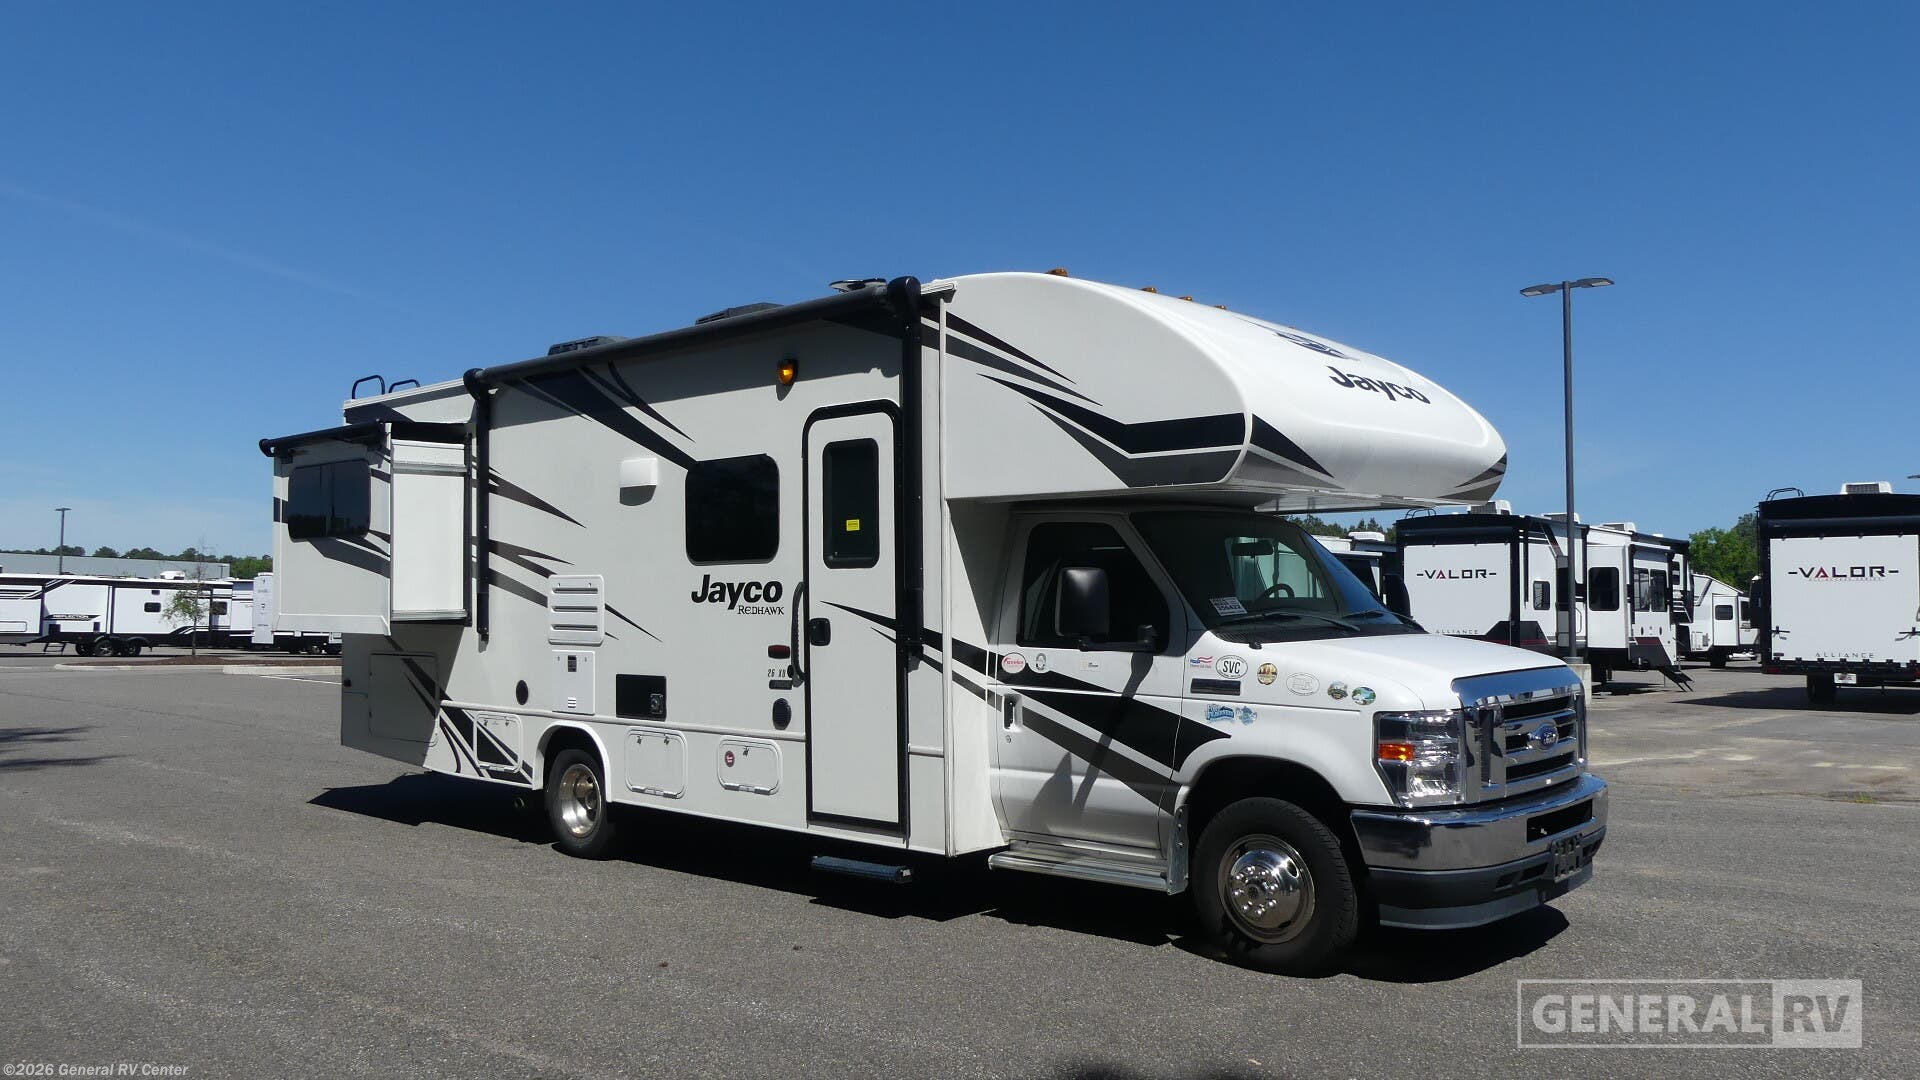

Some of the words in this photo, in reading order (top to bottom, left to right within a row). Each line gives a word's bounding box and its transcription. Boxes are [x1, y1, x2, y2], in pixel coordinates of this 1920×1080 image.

[1325, 365, 1431, 405] Jayco
[691, 574, 783, 610] Jayco
[1222, 660, 1241, 674] SVC
[1815, 651, 1875, 659] ALLIANCE
